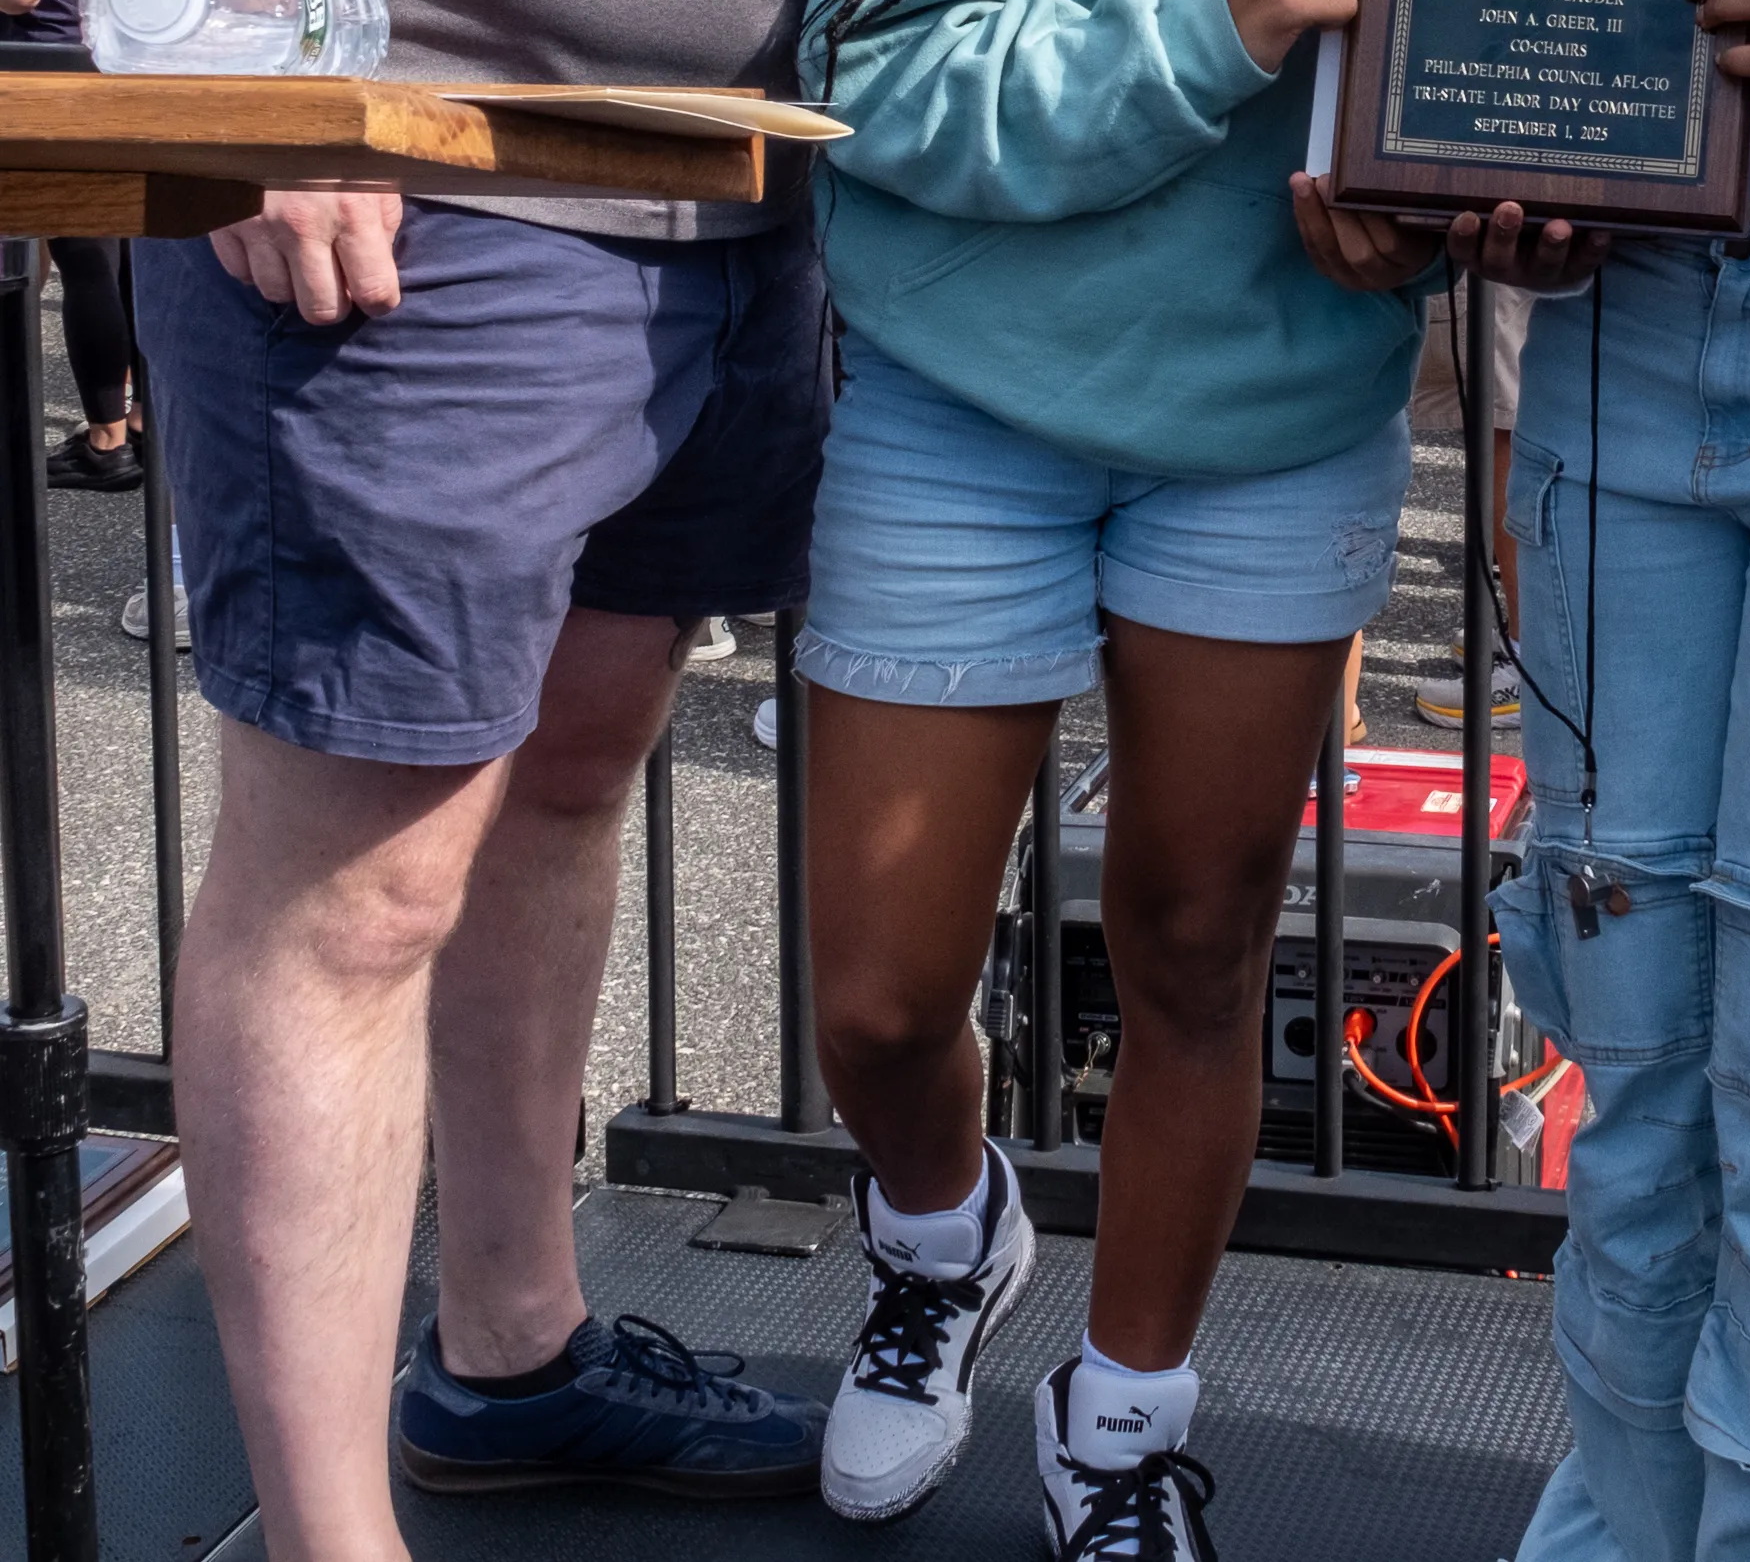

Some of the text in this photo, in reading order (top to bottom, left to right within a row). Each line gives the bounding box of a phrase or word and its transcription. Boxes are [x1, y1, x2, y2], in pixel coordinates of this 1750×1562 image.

[1479, 9, 1622, 33] JOHN A. GREER, III
[1510, 38, 1588, 58] CO-CHAIRS
[1424, 59, 1669, 91] PHILADELPHIA COUNCIL AFL-CIO
[1413, 85, 1676, 120] TRI-STATE LABOR DAY COMMITTEE
[1474, 118, 1609, 141] SEPTEMBER 1, 2025
[877, 1240, 914, 1263] PUMA
[1096, 1415, 1144, 1434] PUMA
